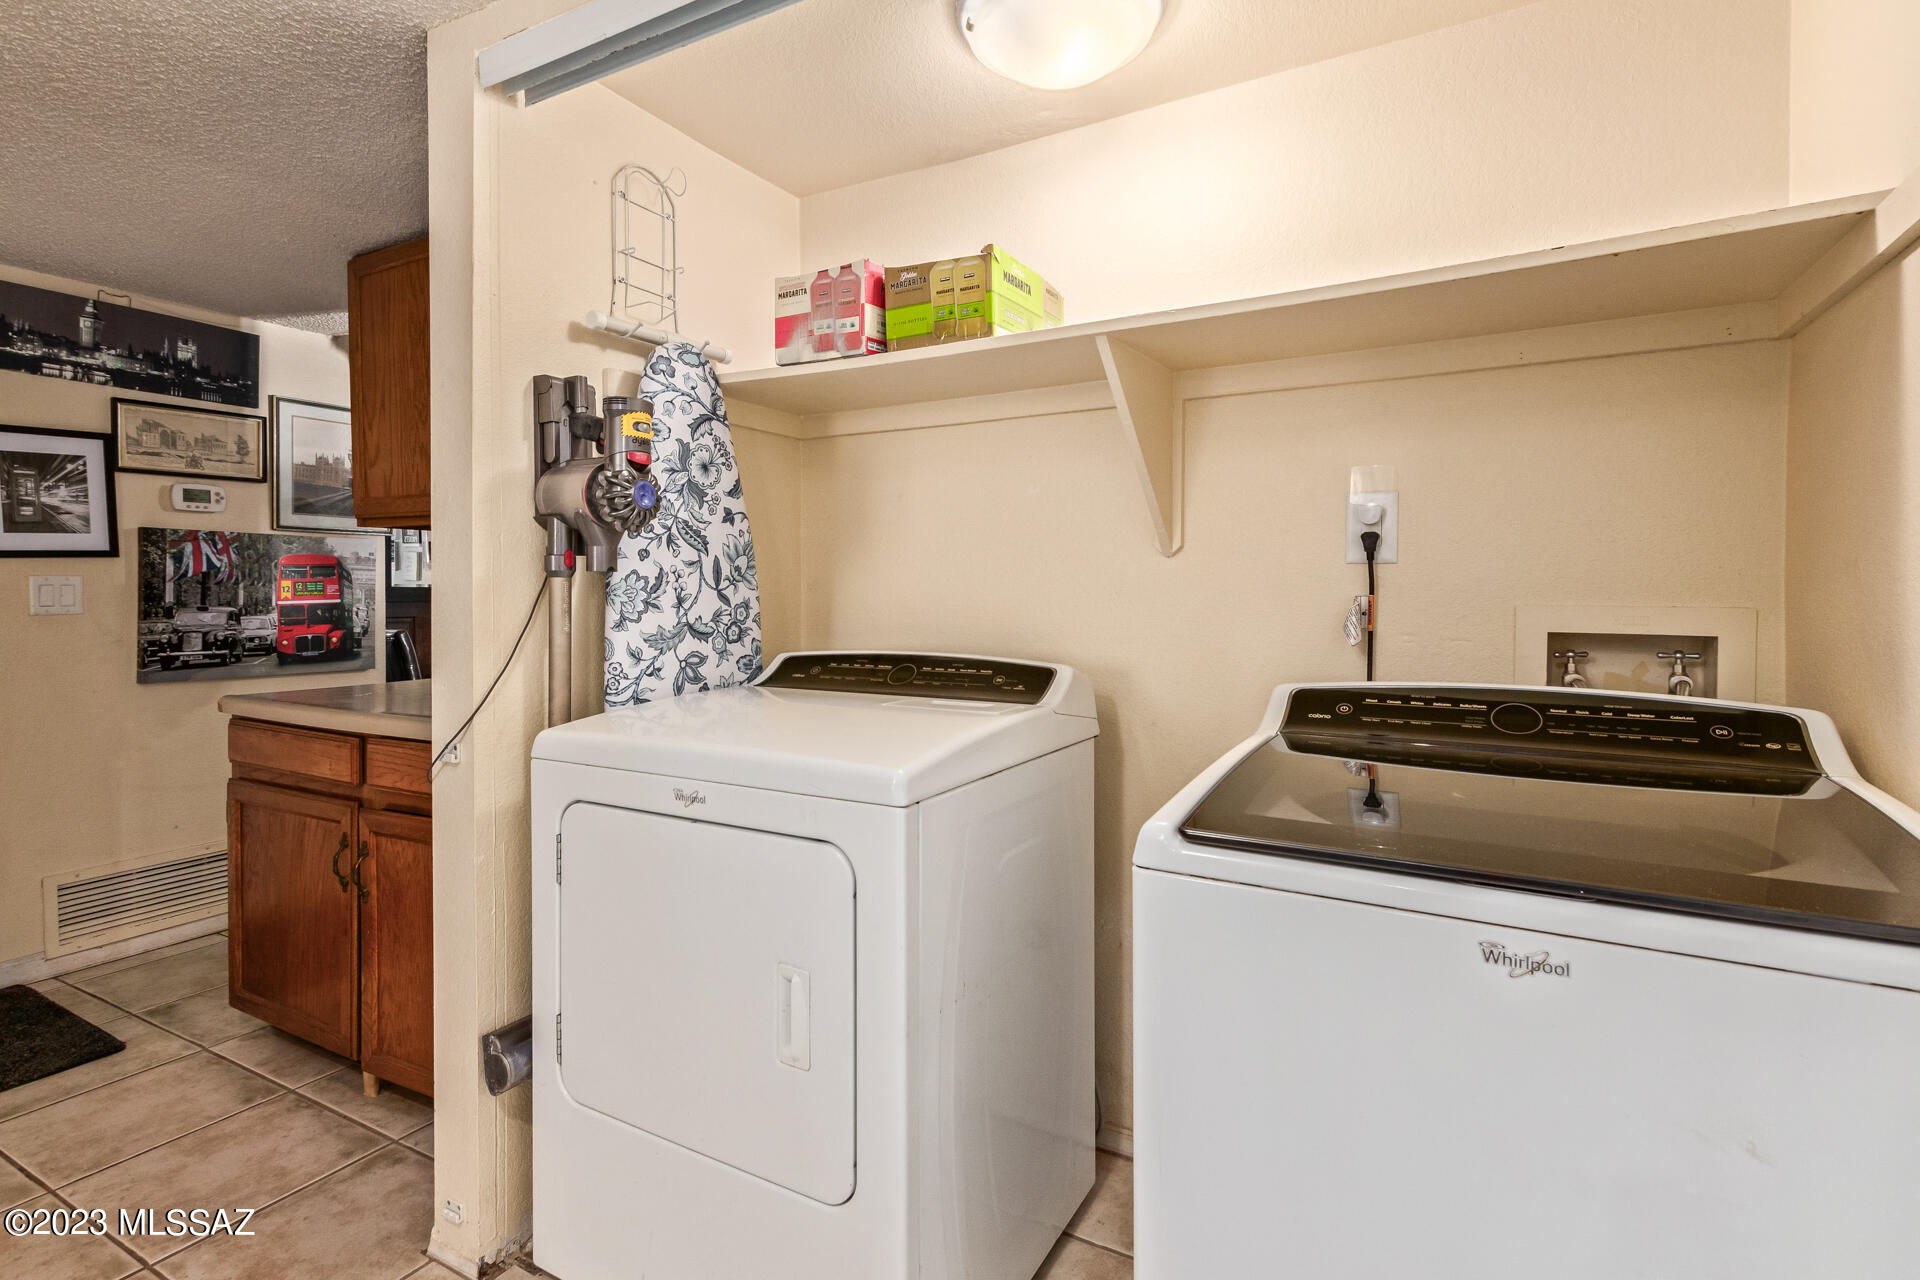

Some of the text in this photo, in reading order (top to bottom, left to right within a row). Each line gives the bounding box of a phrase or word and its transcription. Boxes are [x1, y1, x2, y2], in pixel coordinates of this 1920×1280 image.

[890, 276, 927, 290] MARGARITA
[1003, 269, 1031, 297] MARGARITA
[778, 287, 808, 300] MARGARITA
[673, 788, 706, 807] Whirlpool
[1480, 944, 1570, 977] Whirlpool
